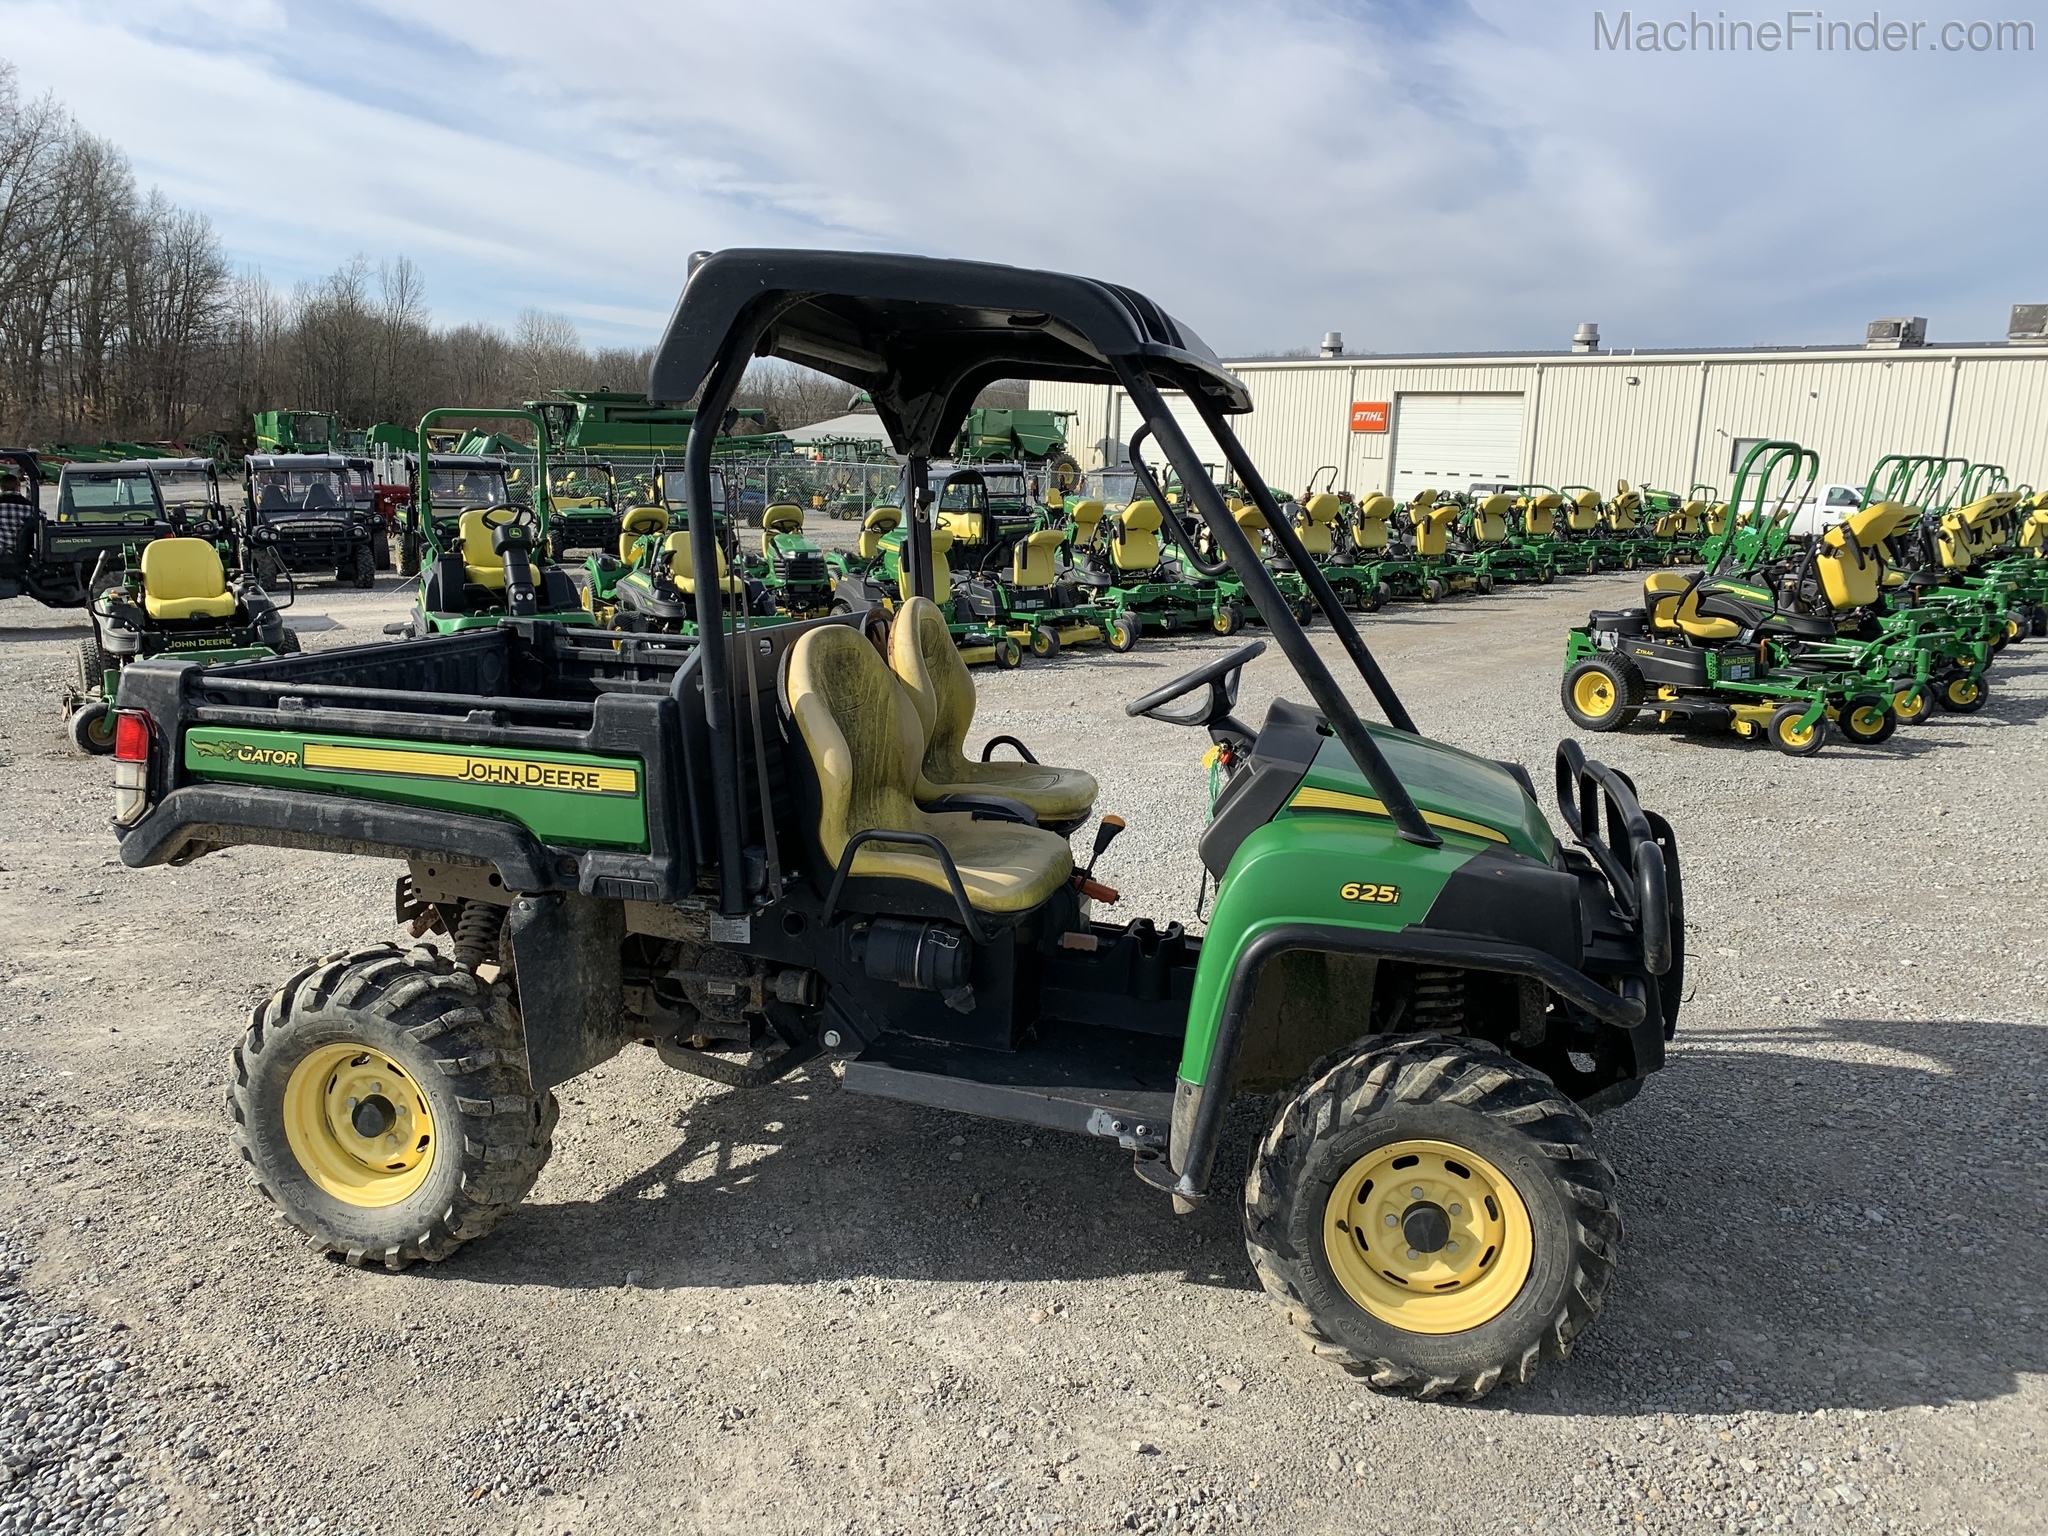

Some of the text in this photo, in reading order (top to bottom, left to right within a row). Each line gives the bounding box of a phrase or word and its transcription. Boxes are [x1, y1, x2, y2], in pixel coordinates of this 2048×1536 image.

[1353, 411, 1385, 421] STIHL
[168, 637, 233, 649] JOHN DEERE
[1722, 656, 1755, 666] JOHN DEERE
[237, 746, 299, 766] GATOR
[457, 759, 601, 791] JOHN DEERE
[1340, 882, 1400, 904] 625i
[1293, 1237, 1335, 1310] ANCLA
